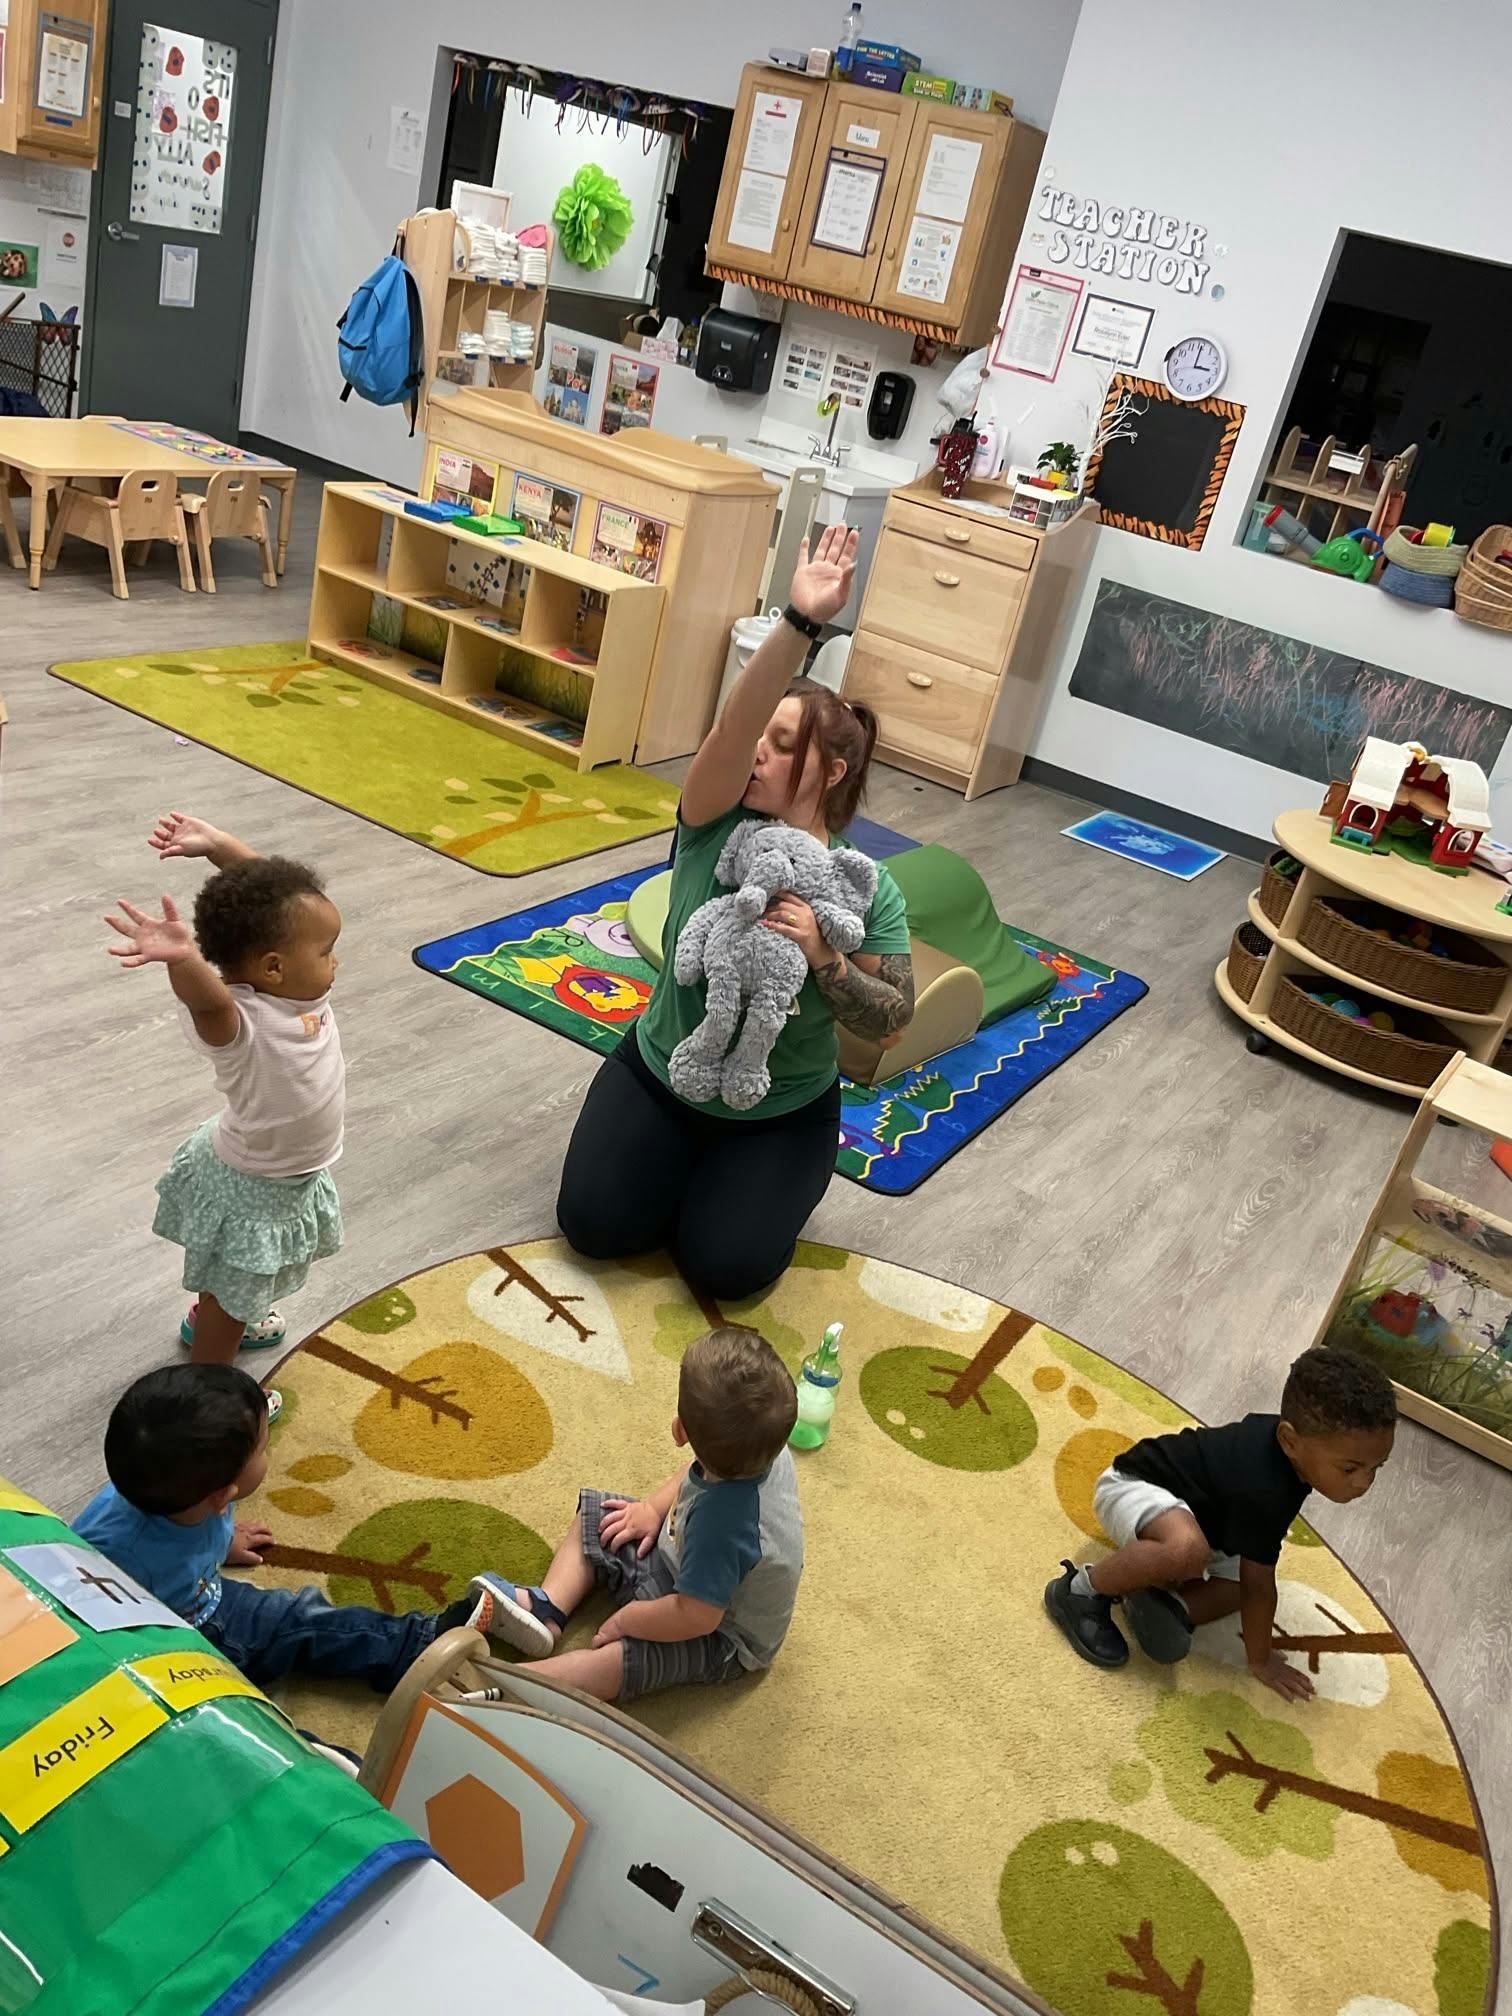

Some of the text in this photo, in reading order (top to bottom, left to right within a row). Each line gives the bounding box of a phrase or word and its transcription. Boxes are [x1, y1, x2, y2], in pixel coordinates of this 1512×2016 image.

[1038, 185, 1207, 259] TEACHER
[1047, 230, 1211, 295] STATION
[438, 457, 456, 468] INDIA
[518, 483, 543, 498] KENYA
[33, 1716, 115, 1778] Friday
